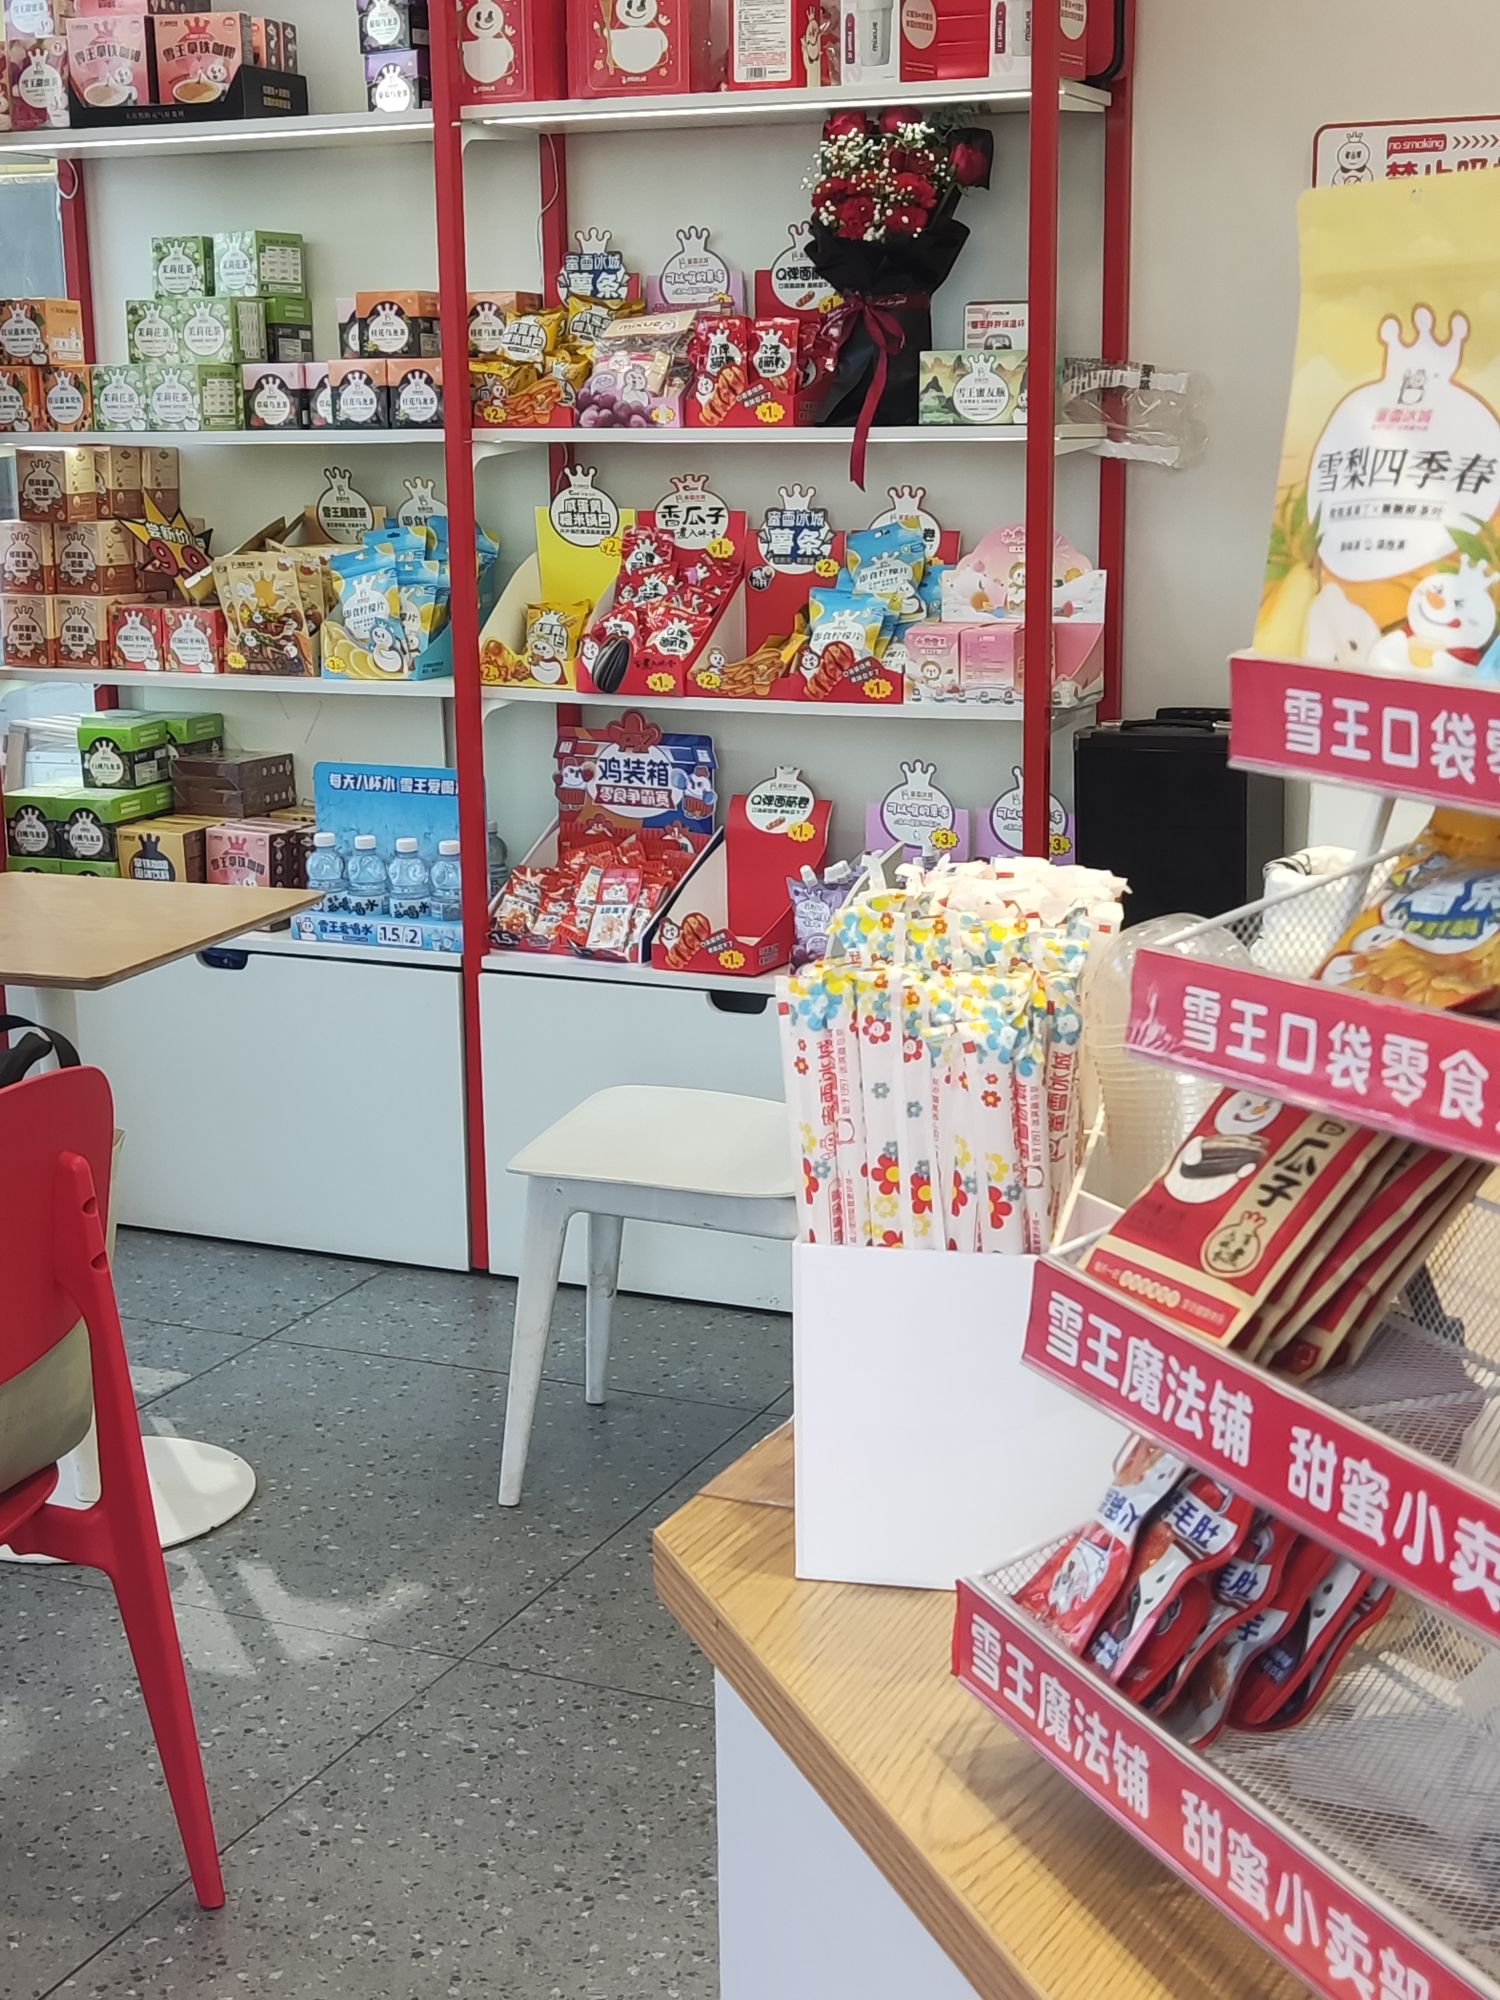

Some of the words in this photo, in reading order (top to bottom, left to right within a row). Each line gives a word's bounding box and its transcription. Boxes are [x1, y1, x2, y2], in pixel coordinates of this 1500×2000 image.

[1388, 141, 1401, 150] no
[1402, 137, 1445, 151] smoking
[565, 253, 621, 271] 蜜雪冰城
[568, 272, 621, 299] 薯条
[1317, 446, 1498, 494] 雪梨四季春
[563, 498, 603, 513] 咸蛋黄
[657, 504, 727, 527] 香瓜子
[558, 512, 611, 528] 糯米锅巴
[767, 510, 825, 528] 蜜雪冰城
[769, 528, 829, 556] 薯条
[1284, 687, 1500, 786] 雪王口袋
[598, 757, 670, 787] 鸡装箱
[329, 773, 396, 793] 每天八杯水
[400, 777, 459, 796] 雪王爱喝
[600, 786, 670, 808] 零食争霸赛
[750, 794, 811, 809] Q弹面筋卷
[886, 802, 950, 819] 可以吸的果冻
[210, 855, 266, 876] 雪王拿铁咖啡
[317, 919, 374, 936] 雪王爱喝水
[1182, 985, 1490, 1128] 雪王口袋零食
[1045, 1291, 1254, 1468] 雪王魔法铺
[1172, 1500, 1220, 1549] 毛肚
[969, 1612, 1151, 1820] 雪王魔法铺
[1180, 1788, 1431, 2000] 甜蜜小卖部
